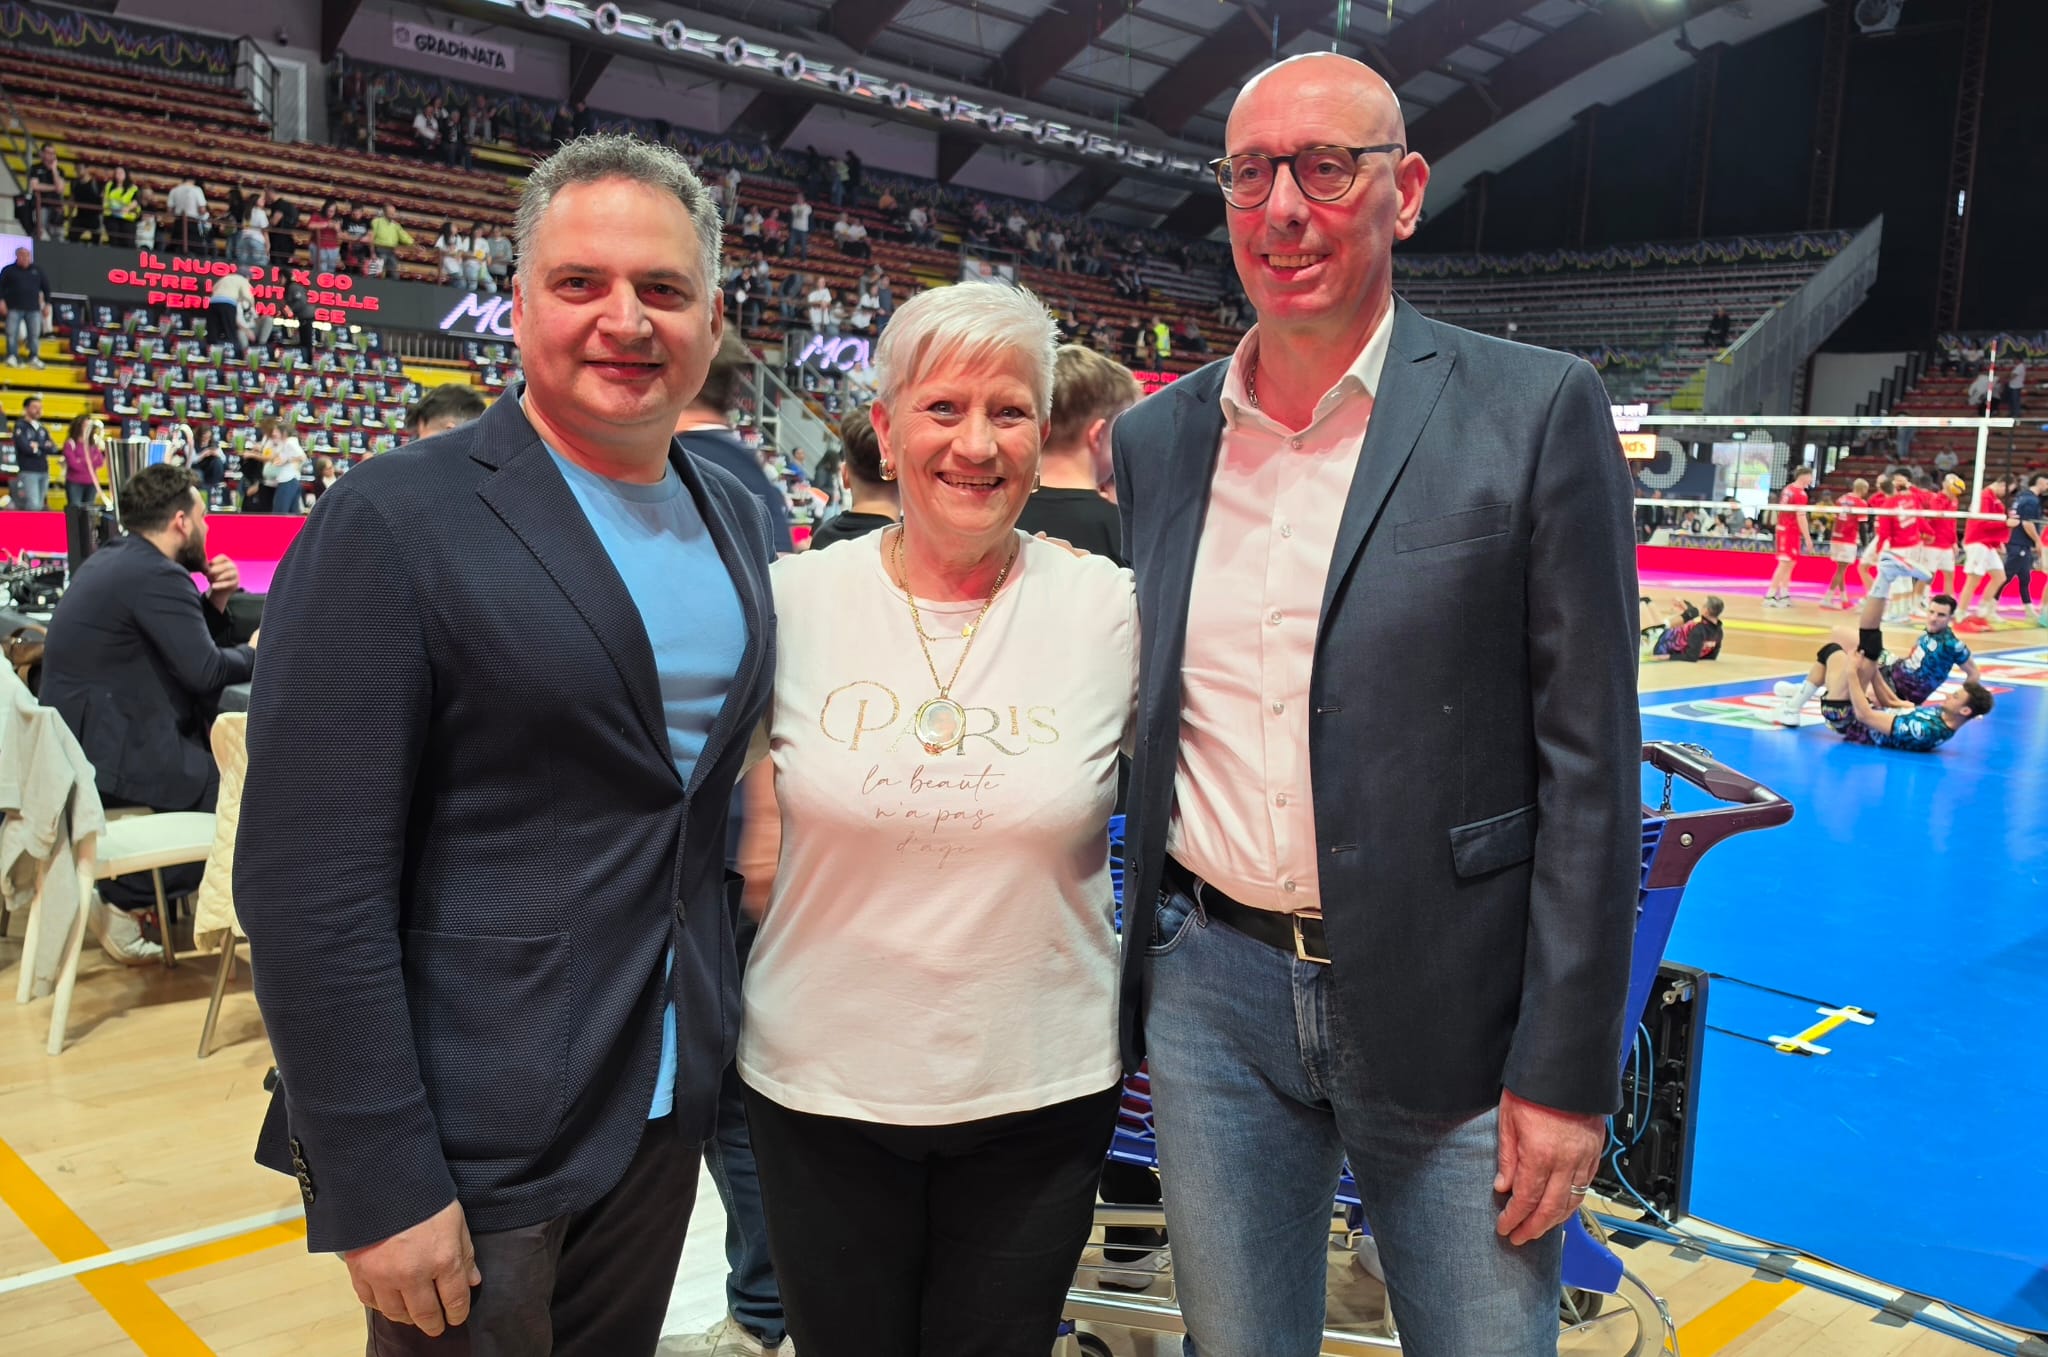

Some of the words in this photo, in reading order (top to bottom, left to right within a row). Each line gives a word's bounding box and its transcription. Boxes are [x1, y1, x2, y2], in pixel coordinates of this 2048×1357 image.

[140, 251, 166, 270] IL
[108, 269, 199, 291] OLTRE
[861, 764, 901, 795] la
[933, 810, 994, 832] pas
